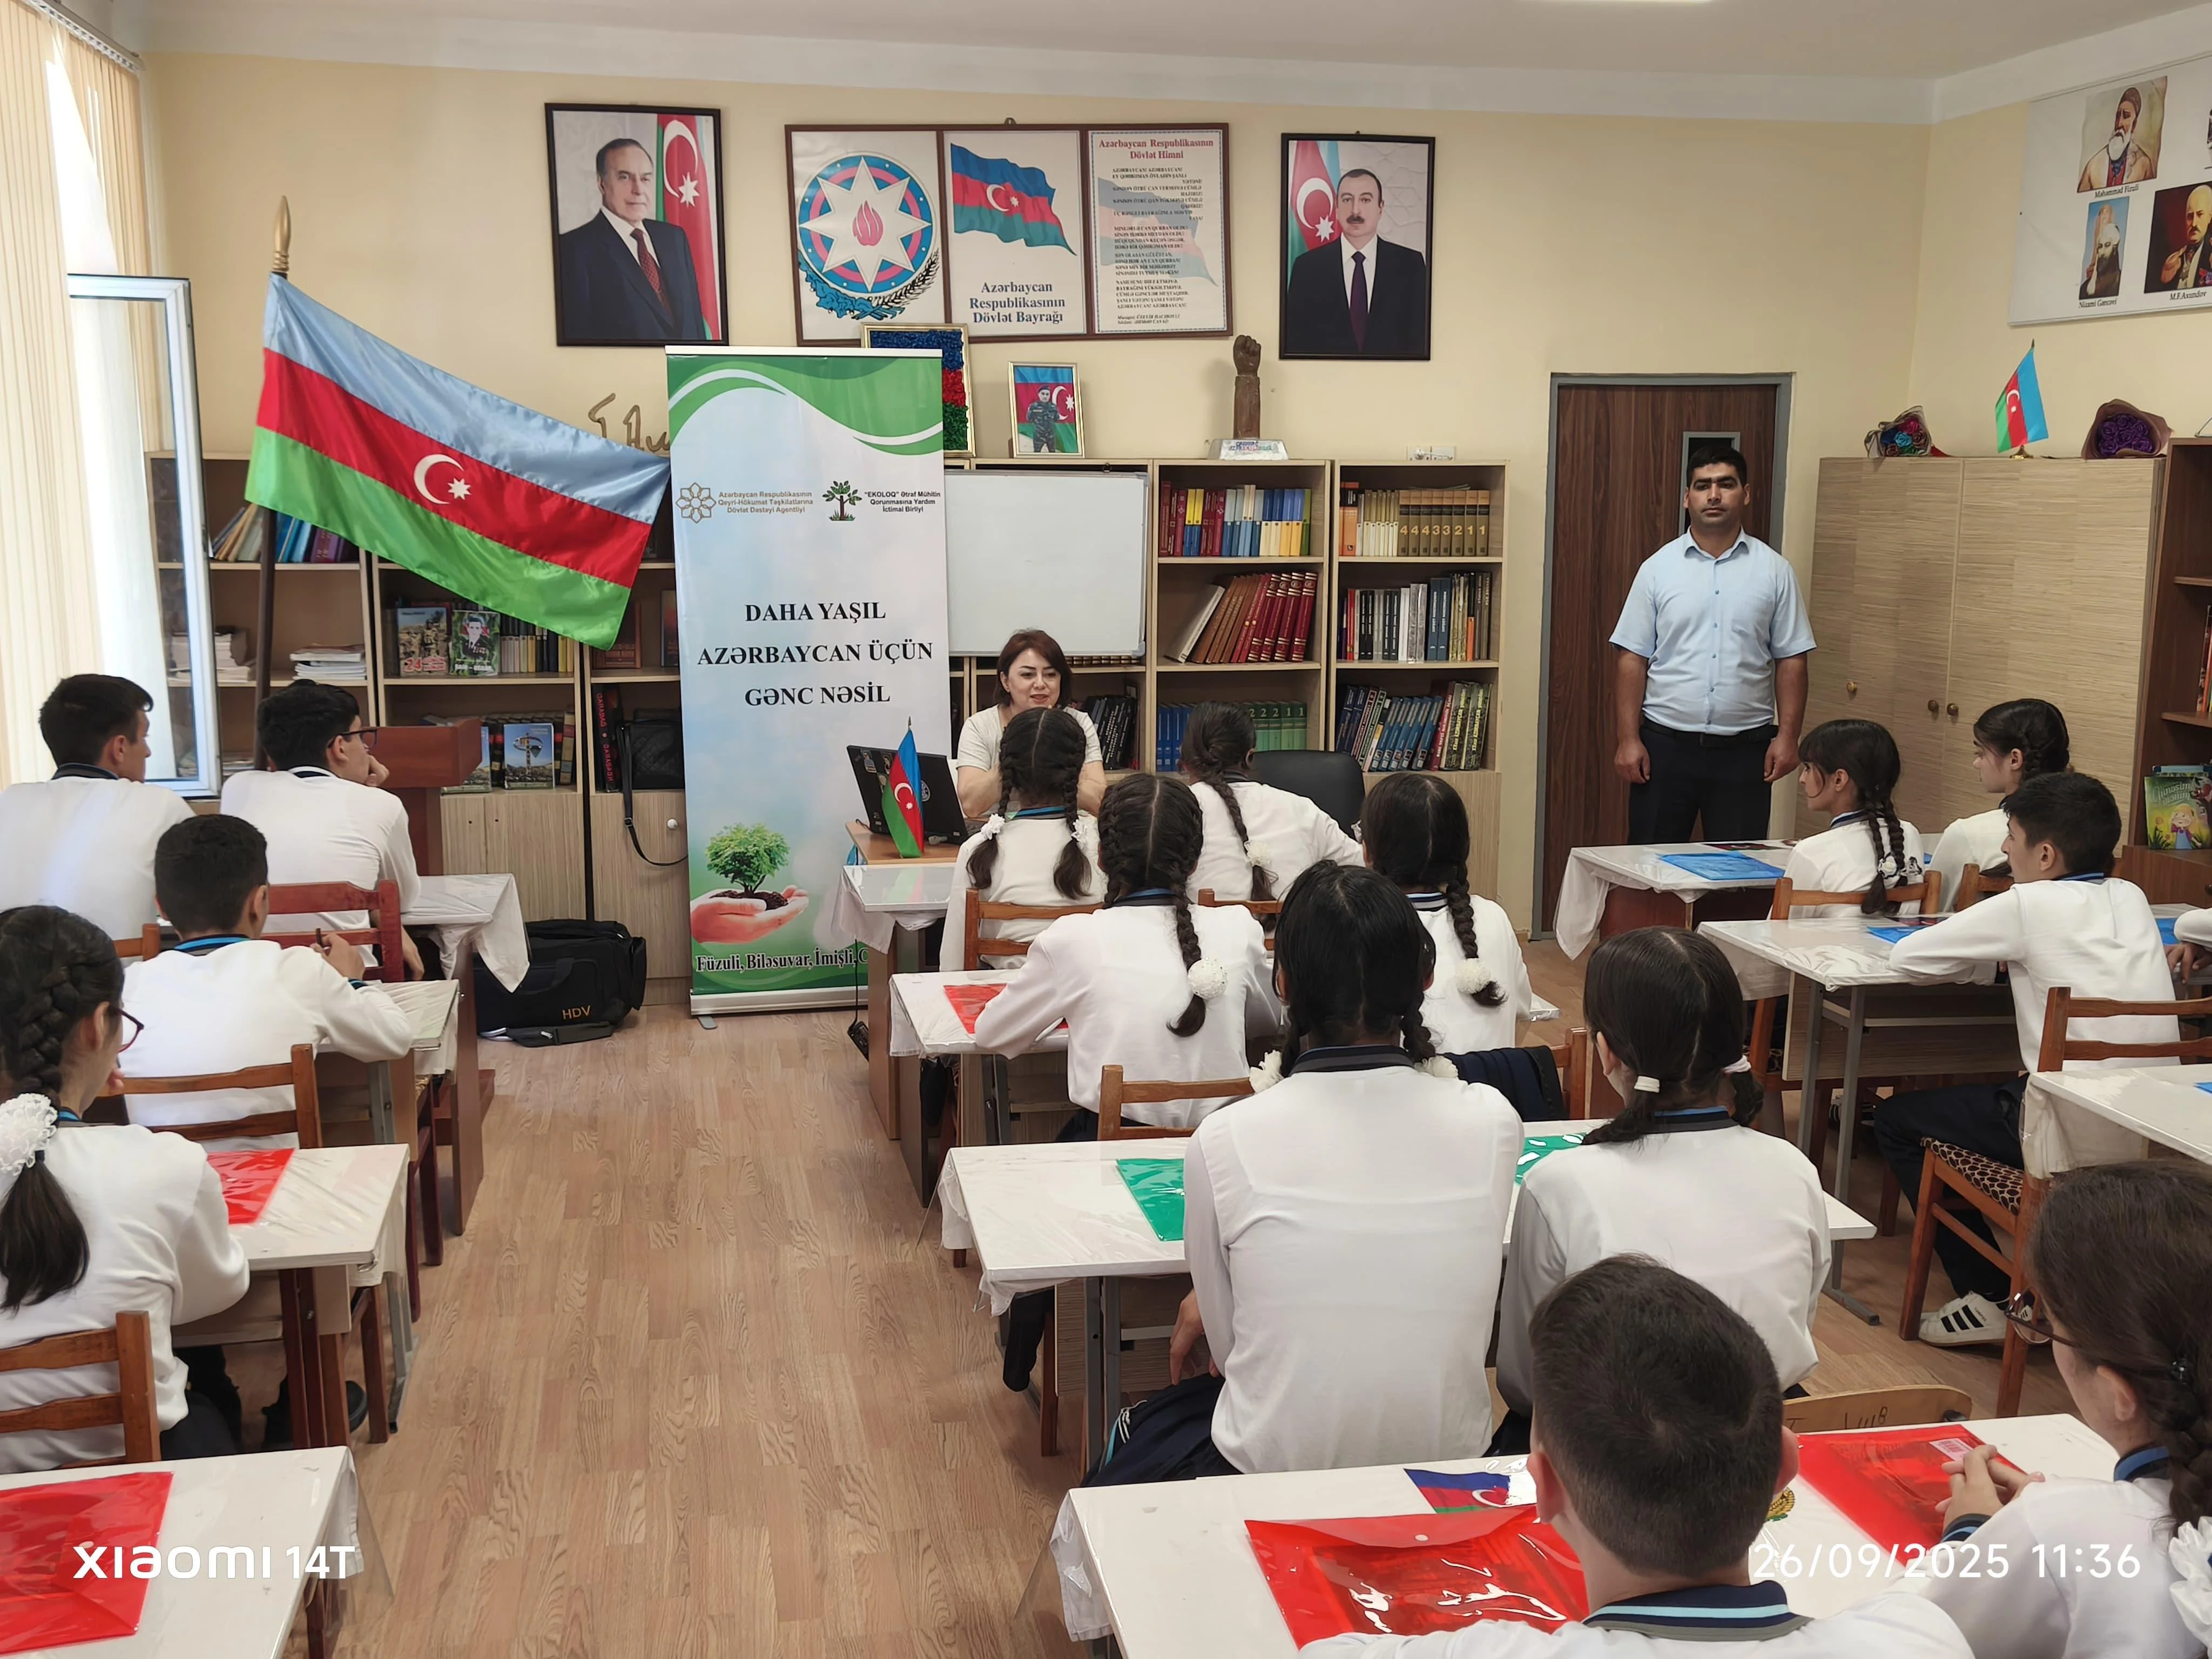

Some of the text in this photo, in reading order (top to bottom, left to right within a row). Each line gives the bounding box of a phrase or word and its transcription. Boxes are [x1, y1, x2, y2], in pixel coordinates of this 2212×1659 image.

[1099, 139, 1213, 149] Azərbaycan Respublikasının
[1130, 150, 1184, 159] Dövlət Himni
[981, 282, 1053, 294] Azərbaycan
[969, 297, 1065, 311] Respublikasının
[973, 311, 1063, 324] Dövlət Bayrağı
[1400, 525, 1408, 535] 4
[1411, 525, 1419, 535] 4
[1421, 525, 1430, 535] 4
[1432, 525, 1440, 535] 3
[1442, 525, 1451, 535] 3
[1454, 525, 1462, 535] 2
[1467, 525, 1473, 535] 1
[1479, 525, 1485, 535] 1
[744, 602, 886, 623] DAHA YAŞIL
[697, 644, 861, 665] AZƏRBAYCAN
[868, 638, 933, 664] ÜÇÜN
[745, 681, 891, 706] GƏNC NƏSİL
[1260, 708, 1267, 717] 2
[1272, 708, 1279, 717] 2
[1286, 707, 1291, 716] 1
[1299, 707, 1304, 716] 1
[696, 954, 744, 974] Füzuli,
[746, 952, 813, 970] Biləsuvar,
[813, 947, 857, 968] İmişli,
[562, 1006, 591, 1020] HDV
